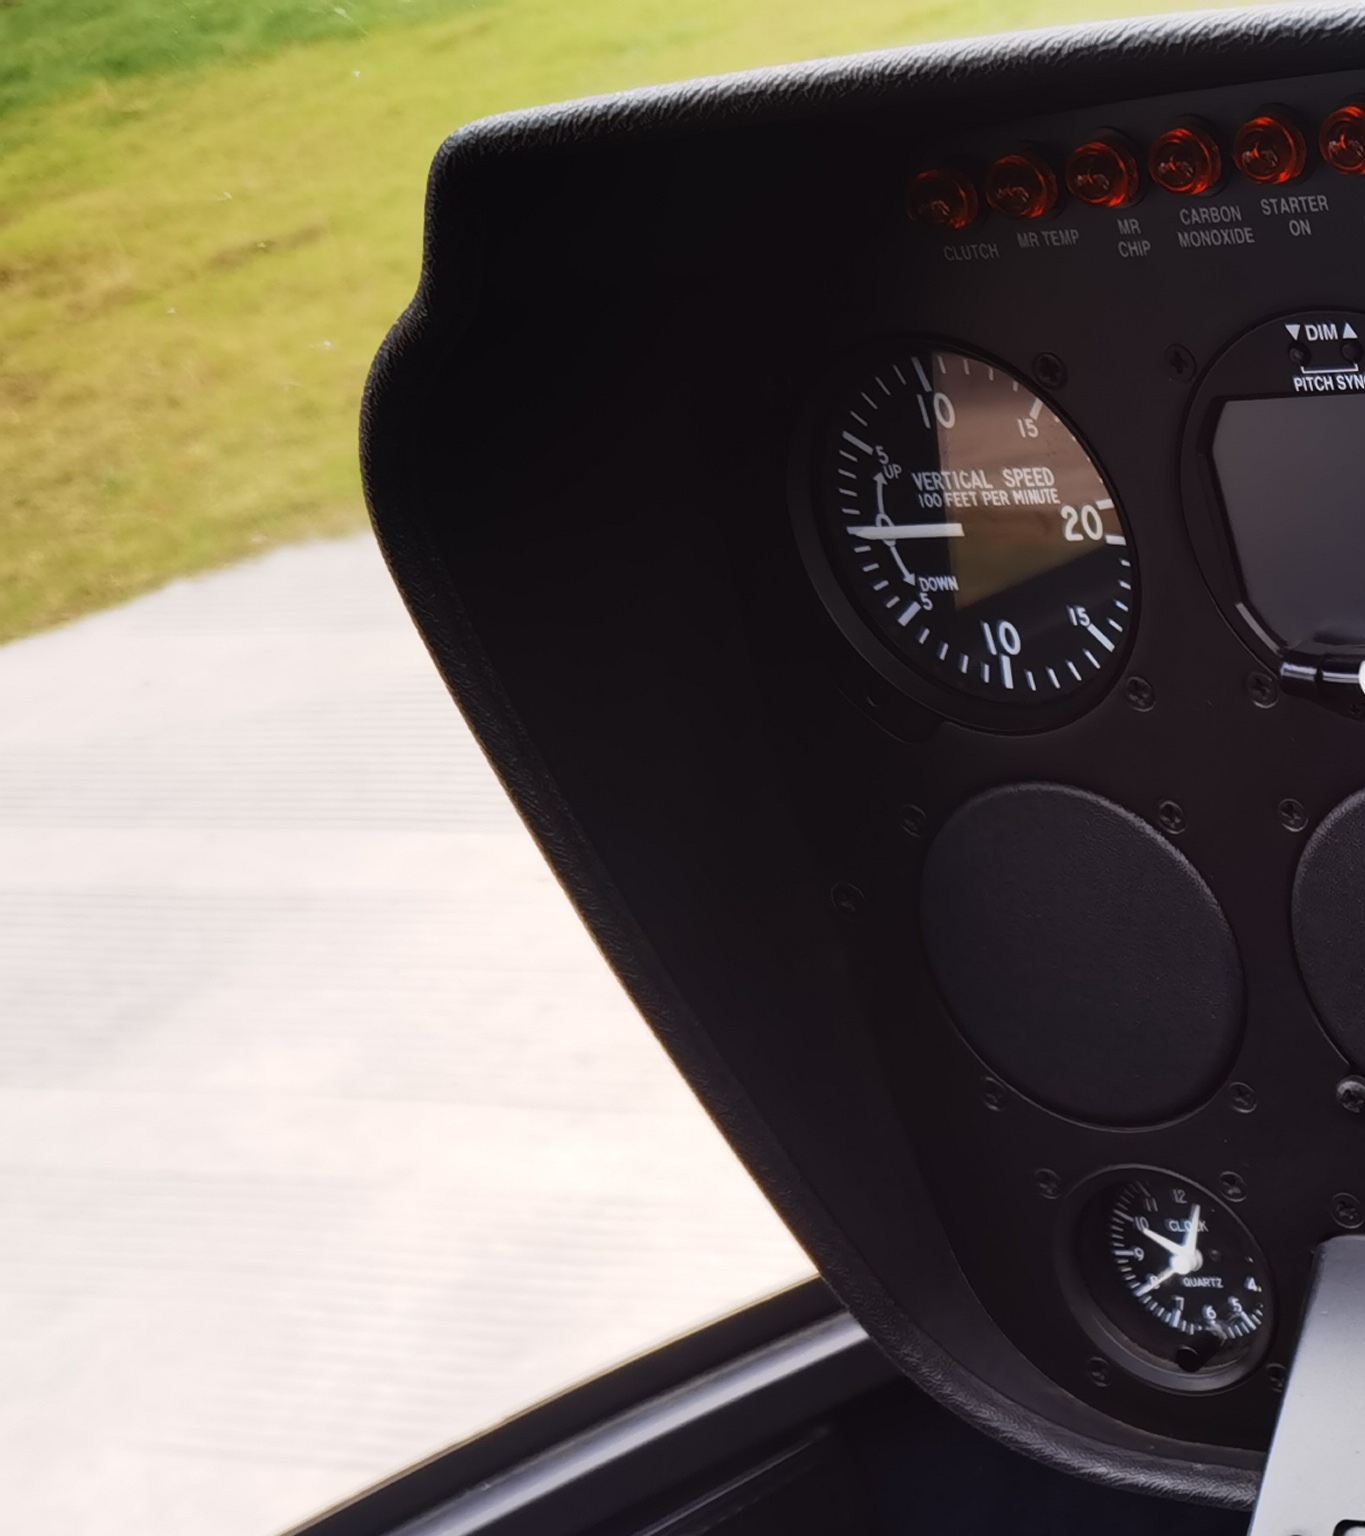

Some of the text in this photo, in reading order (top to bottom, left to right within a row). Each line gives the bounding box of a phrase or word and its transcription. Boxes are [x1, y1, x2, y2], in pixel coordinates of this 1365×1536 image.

[1180, 205, 1242, 225] CARBON
[1260, 195, 1329, 216] STARTER
[1117, 219, 1140, 236] MR
[1289, 218, 1312, 236] ON
[1017, 230, 1080, 248] MR TEMP
[1178, 227, 1255, 248] MONOXIDE
[944, 243, 999, 262] CLUTCH
[1118, 240, 1151, 258] CHIP
[1305, 325, 1338, 341] DIM
[1294, 376, 1334, 392] PITCH
[912, 467, 1055, 491] VERTICAL SPEED
[918, 488, 1060, 507] 100 FEET PER MINUTE
[1061, 504, 1103, 541] 20
[919, 576, 959, 591] DOWN
[981, 621, 1021, 655] 10
